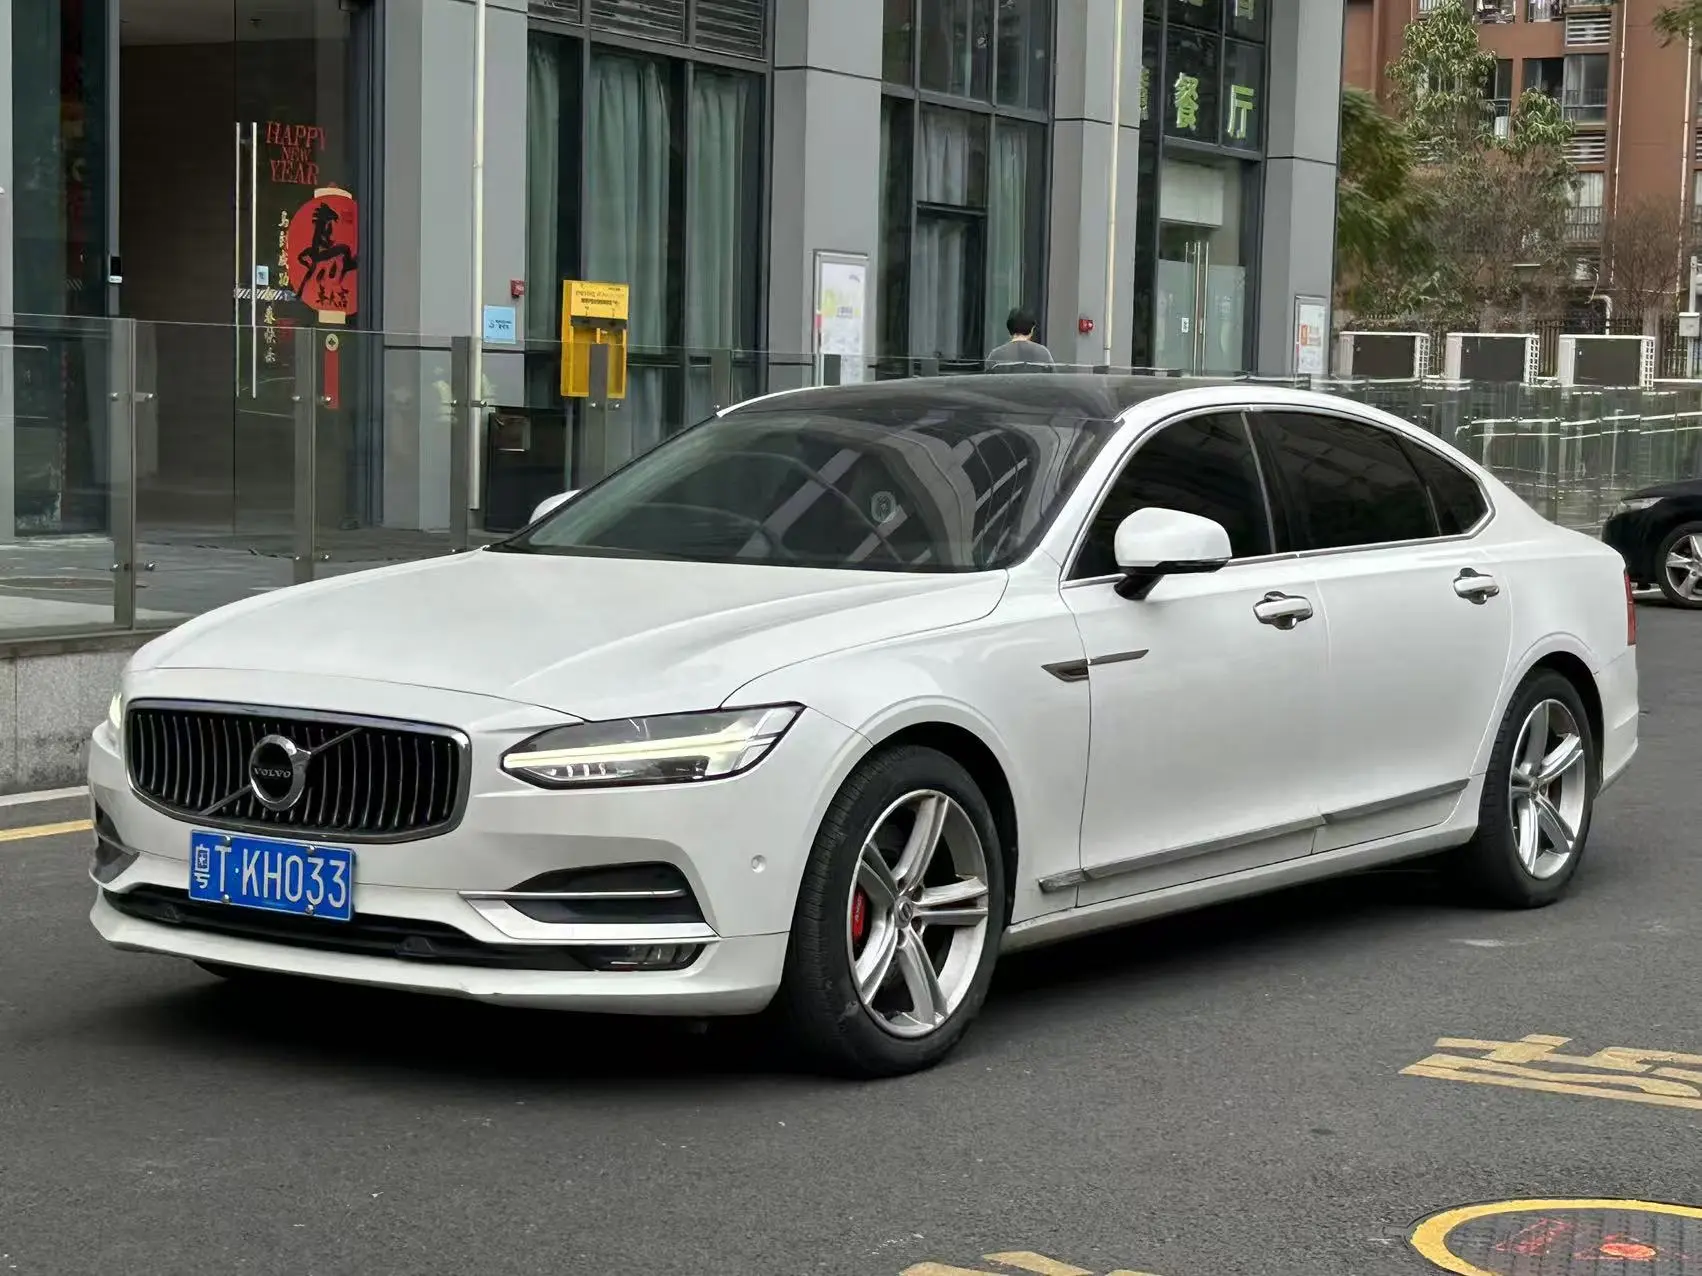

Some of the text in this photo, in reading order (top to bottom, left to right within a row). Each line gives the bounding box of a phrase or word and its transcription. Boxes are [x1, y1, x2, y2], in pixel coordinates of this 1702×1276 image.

[266, 121, 326, 150] HAPPY
[283, 147, 311, 162] NEW
[271, 160, 318, 185] YEAR
[254, 767, 291, 779] VOLVO
